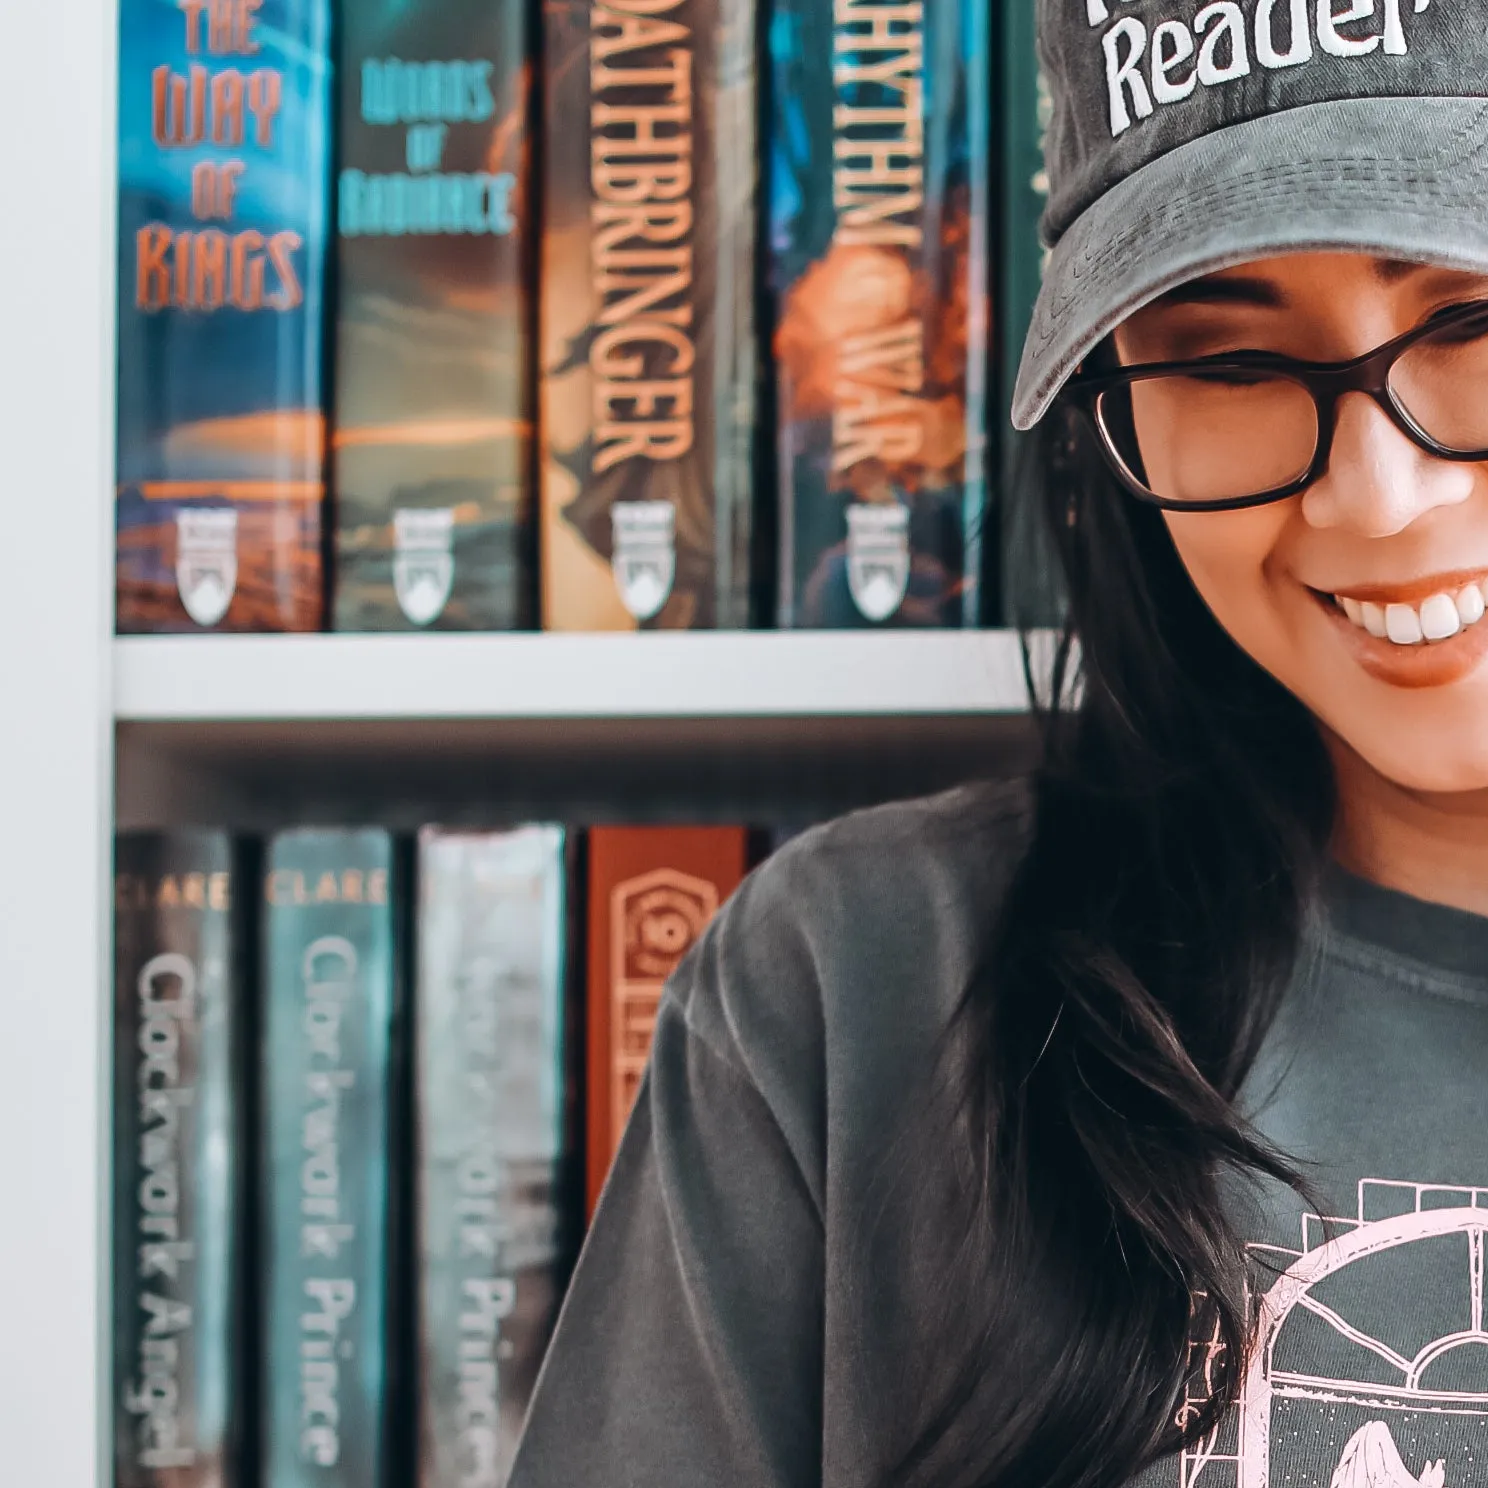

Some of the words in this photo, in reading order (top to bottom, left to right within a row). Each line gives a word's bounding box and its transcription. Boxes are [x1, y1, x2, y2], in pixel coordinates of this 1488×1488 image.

[180, 0, 264, 54] THE
[1102, 0, 1430, 137] Reader
[152, 63, 282, 149] WAY
[833, 0, 924, 246] HYTHM
[136, 223, 303, 311] KINGS
[191, 160, 246, 220] OF
[590, 0, 694, 472] ATHBRINGER
[832, 318, 923, 473] WAR
[266, 868, 388, 905] CLARE
[137, 952, 197, 1279] Clockwork
[301, 934, 358, 1259] Clockwork
[119, 1291, 197, 1468] Angel
[301, 1277, 358, 1467] Prince
